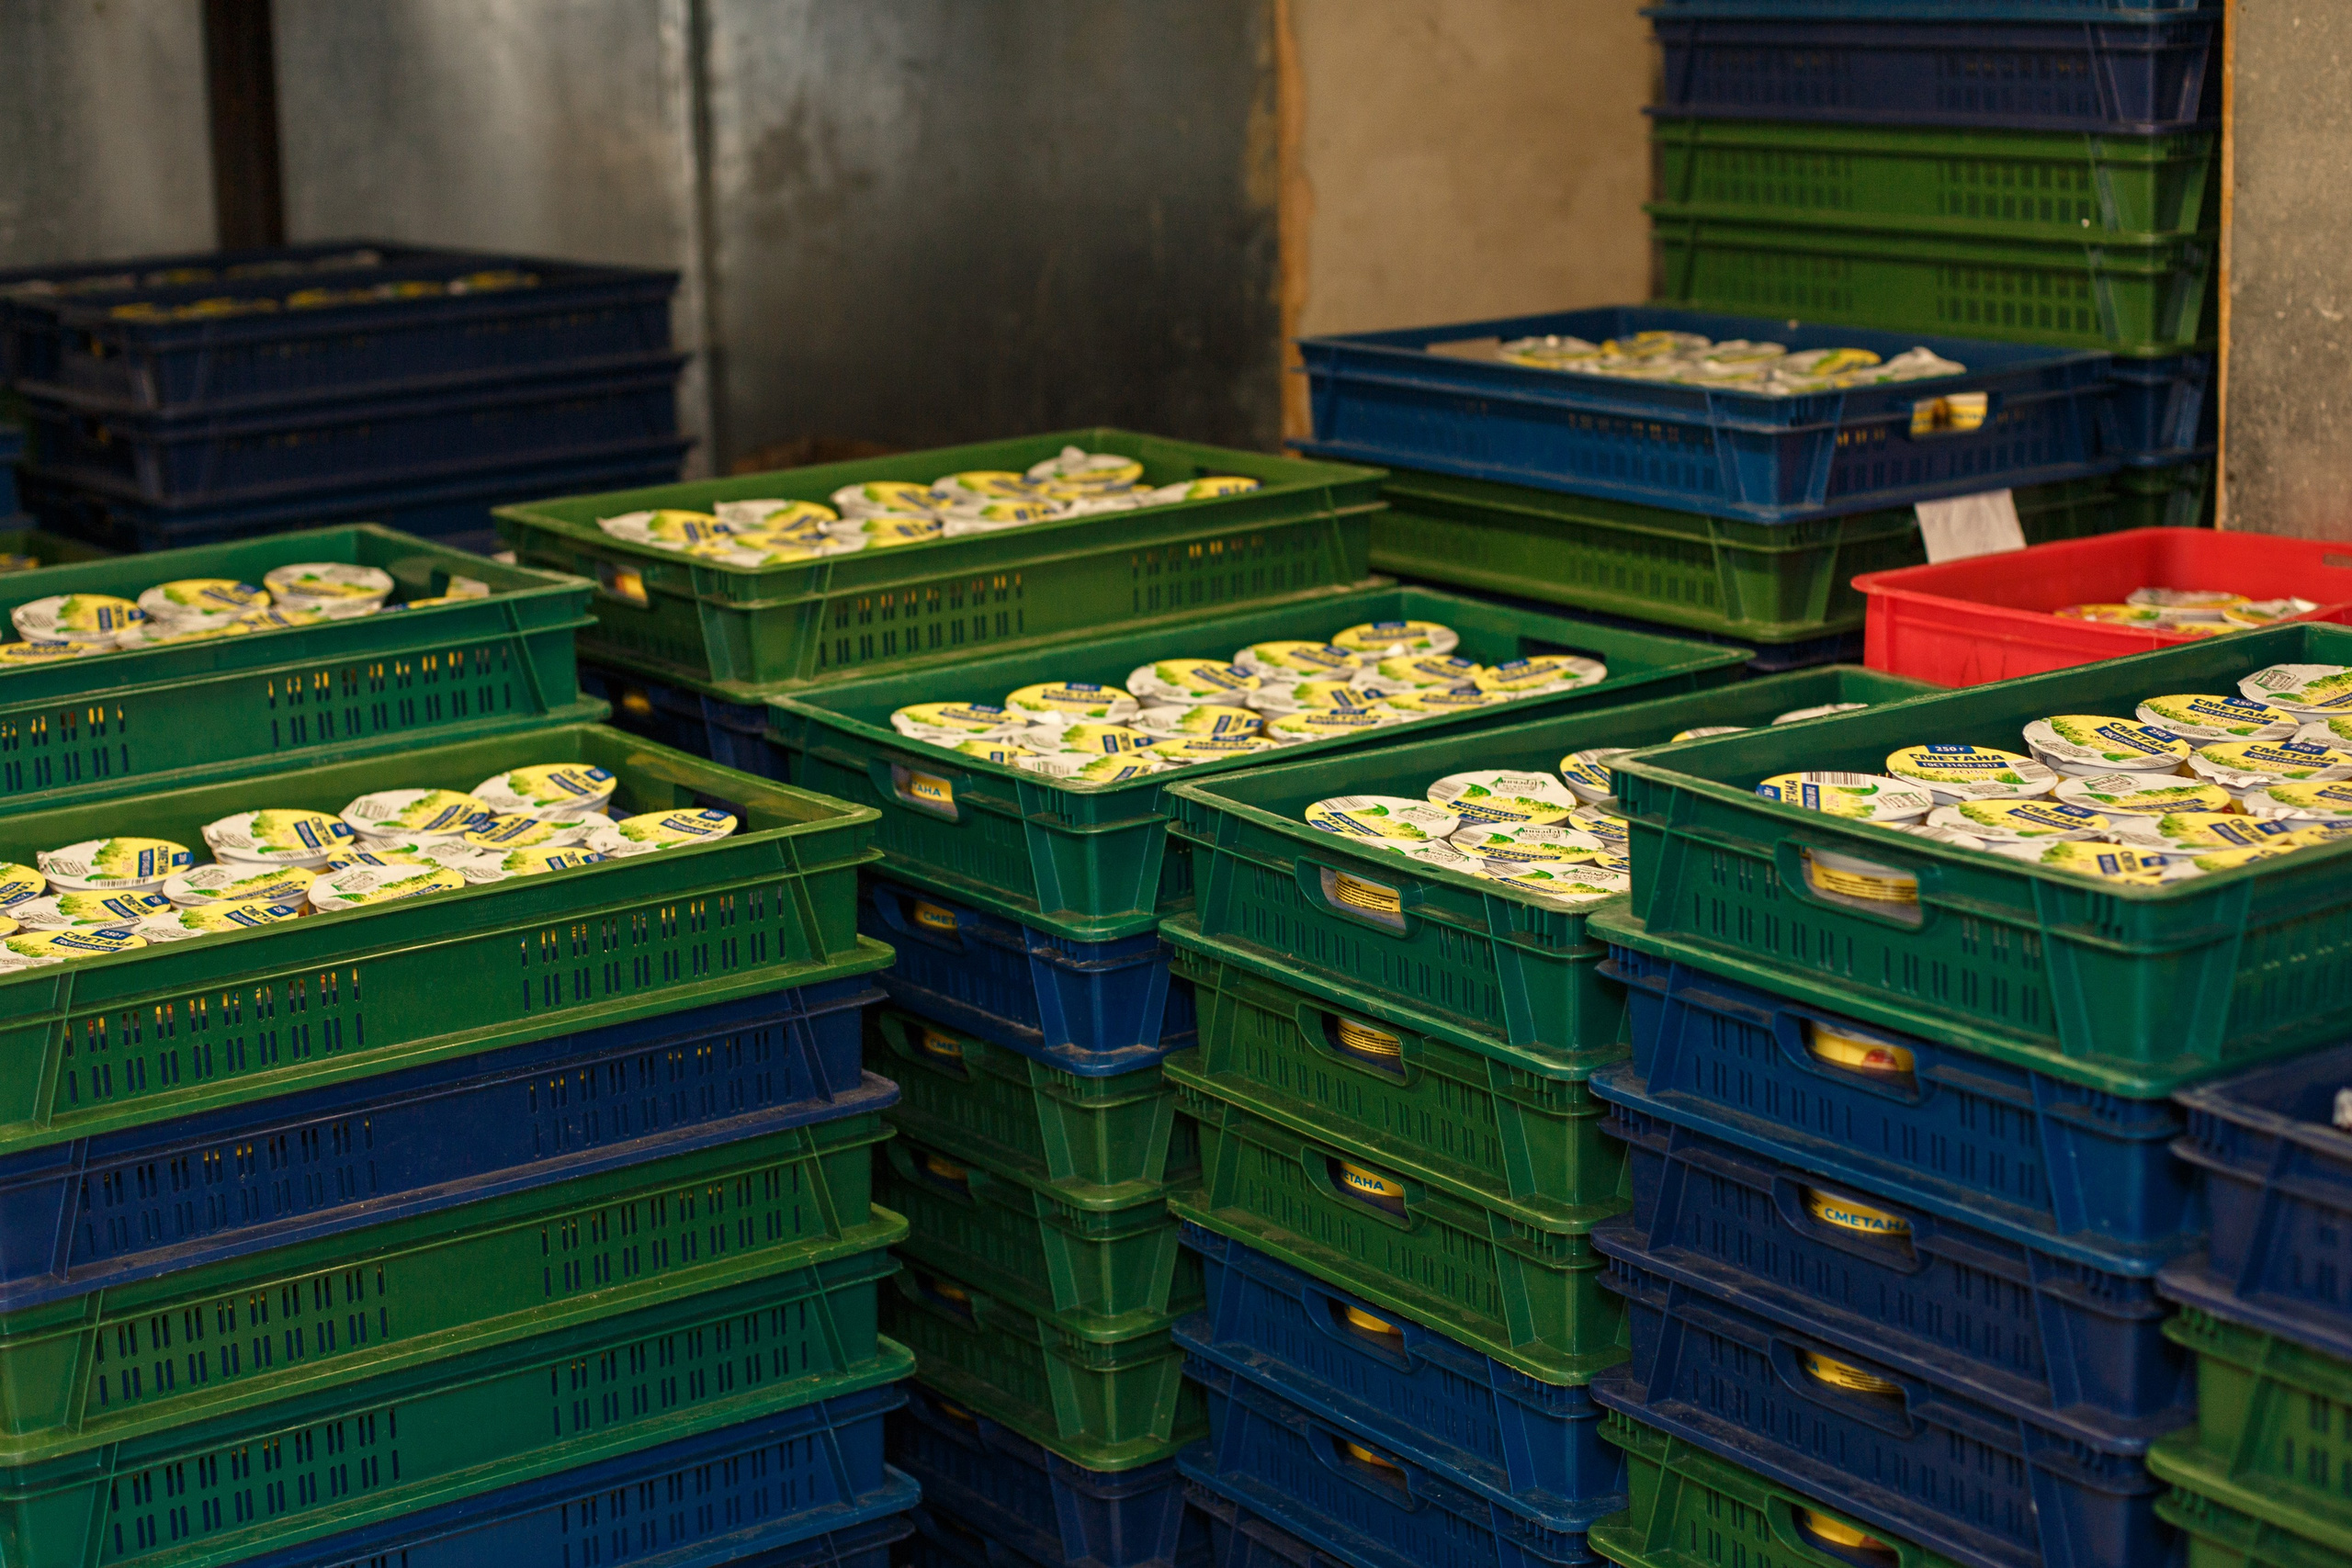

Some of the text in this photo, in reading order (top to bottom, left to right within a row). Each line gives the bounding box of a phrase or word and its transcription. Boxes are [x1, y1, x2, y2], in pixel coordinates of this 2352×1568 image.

[2193, 698, 2280, 720] СМЕТАНА
[2194, 706, 2264, 724] ГОСТ 31452-2012
[2202, 716, 2239, 726] 20%
[2100, 729, 2117, 739] ГОСТ
[2109, 722, 2177, 752] СМЕТАНА
[2146, 727, 2166, 739] 250
[1908, 753, 2006, 761] СМЕТАНА
[2249, 745, 2339, 763] СМЕТАНА
[2250, 752, 2272, 761] ГОСТ
[2021, 804, 2096, 827] СМЕТАНА
[120, 894, 154, 915] СМЕТАНА
[62, 931, 134, 946] СМЕТАНА
[1343, 1169, 1385, 1191] ЕТАНА
